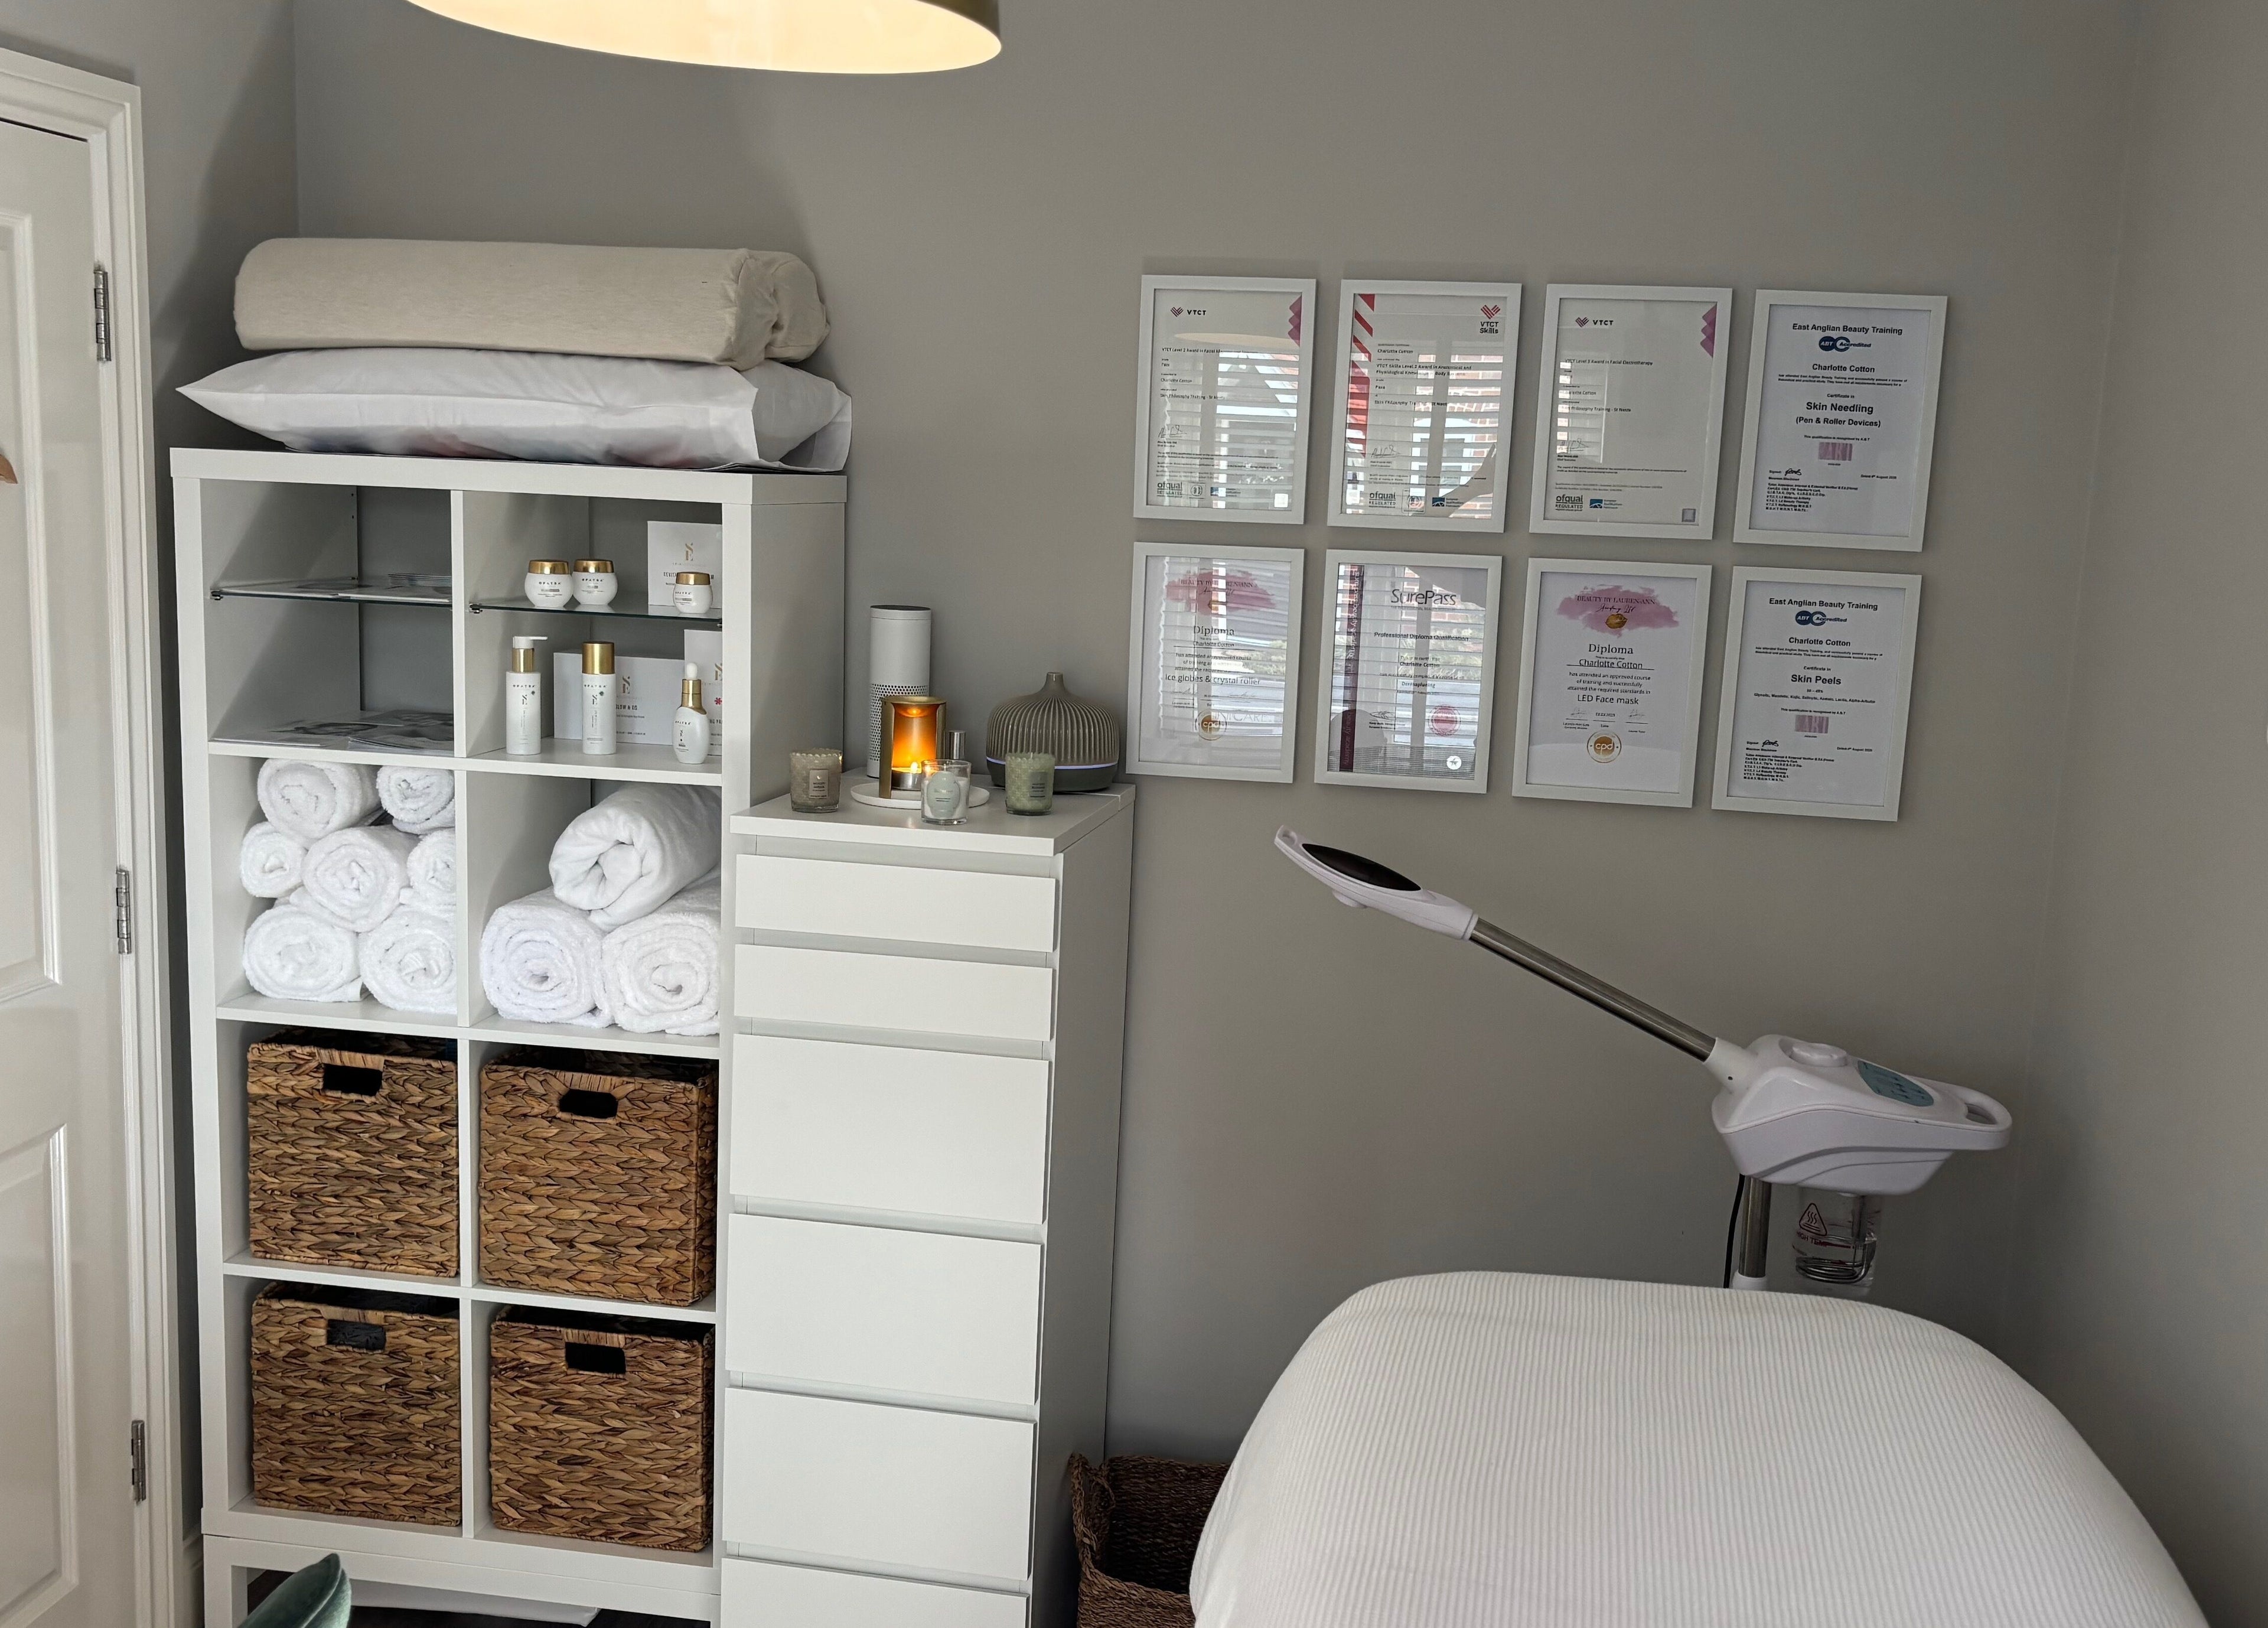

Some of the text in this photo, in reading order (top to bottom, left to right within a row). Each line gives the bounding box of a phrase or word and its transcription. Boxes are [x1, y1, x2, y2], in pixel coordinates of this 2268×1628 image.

[1843, 325, 1869, 334] Beauty
[1872, 326, 1903, 335] Training
[1806, 402, 1873, 415] Skin Needling
[1795, 416, 1813, 424] (Pen
[1847, 419, 1881, 428] Devices)
[1369, 491, 1396, 500] ofqual
[1556, 494, 1583, 504] ofqual
[1391, 589, 1456, 605] SurePass
[1788, 599, 1816, 607] Anglian
[1819, 600, 1845, 609] Beauty
[1847, 601, 1878, 611] Training
[1194, 626, 1234, 636] Diploma
[1788, 637, 1823, 645] Charlotte
[1588, 643, 1634, 655] Diploma
[1579, 659, 1643, 669] Charlotte Cotton
[1178, 674, 1203, 683] globes
[1213, 676, 1239, 685] crystal
[1791, 674, 1842, 685] Skin Peels
[1595, 736, 1614, 755] cpd
